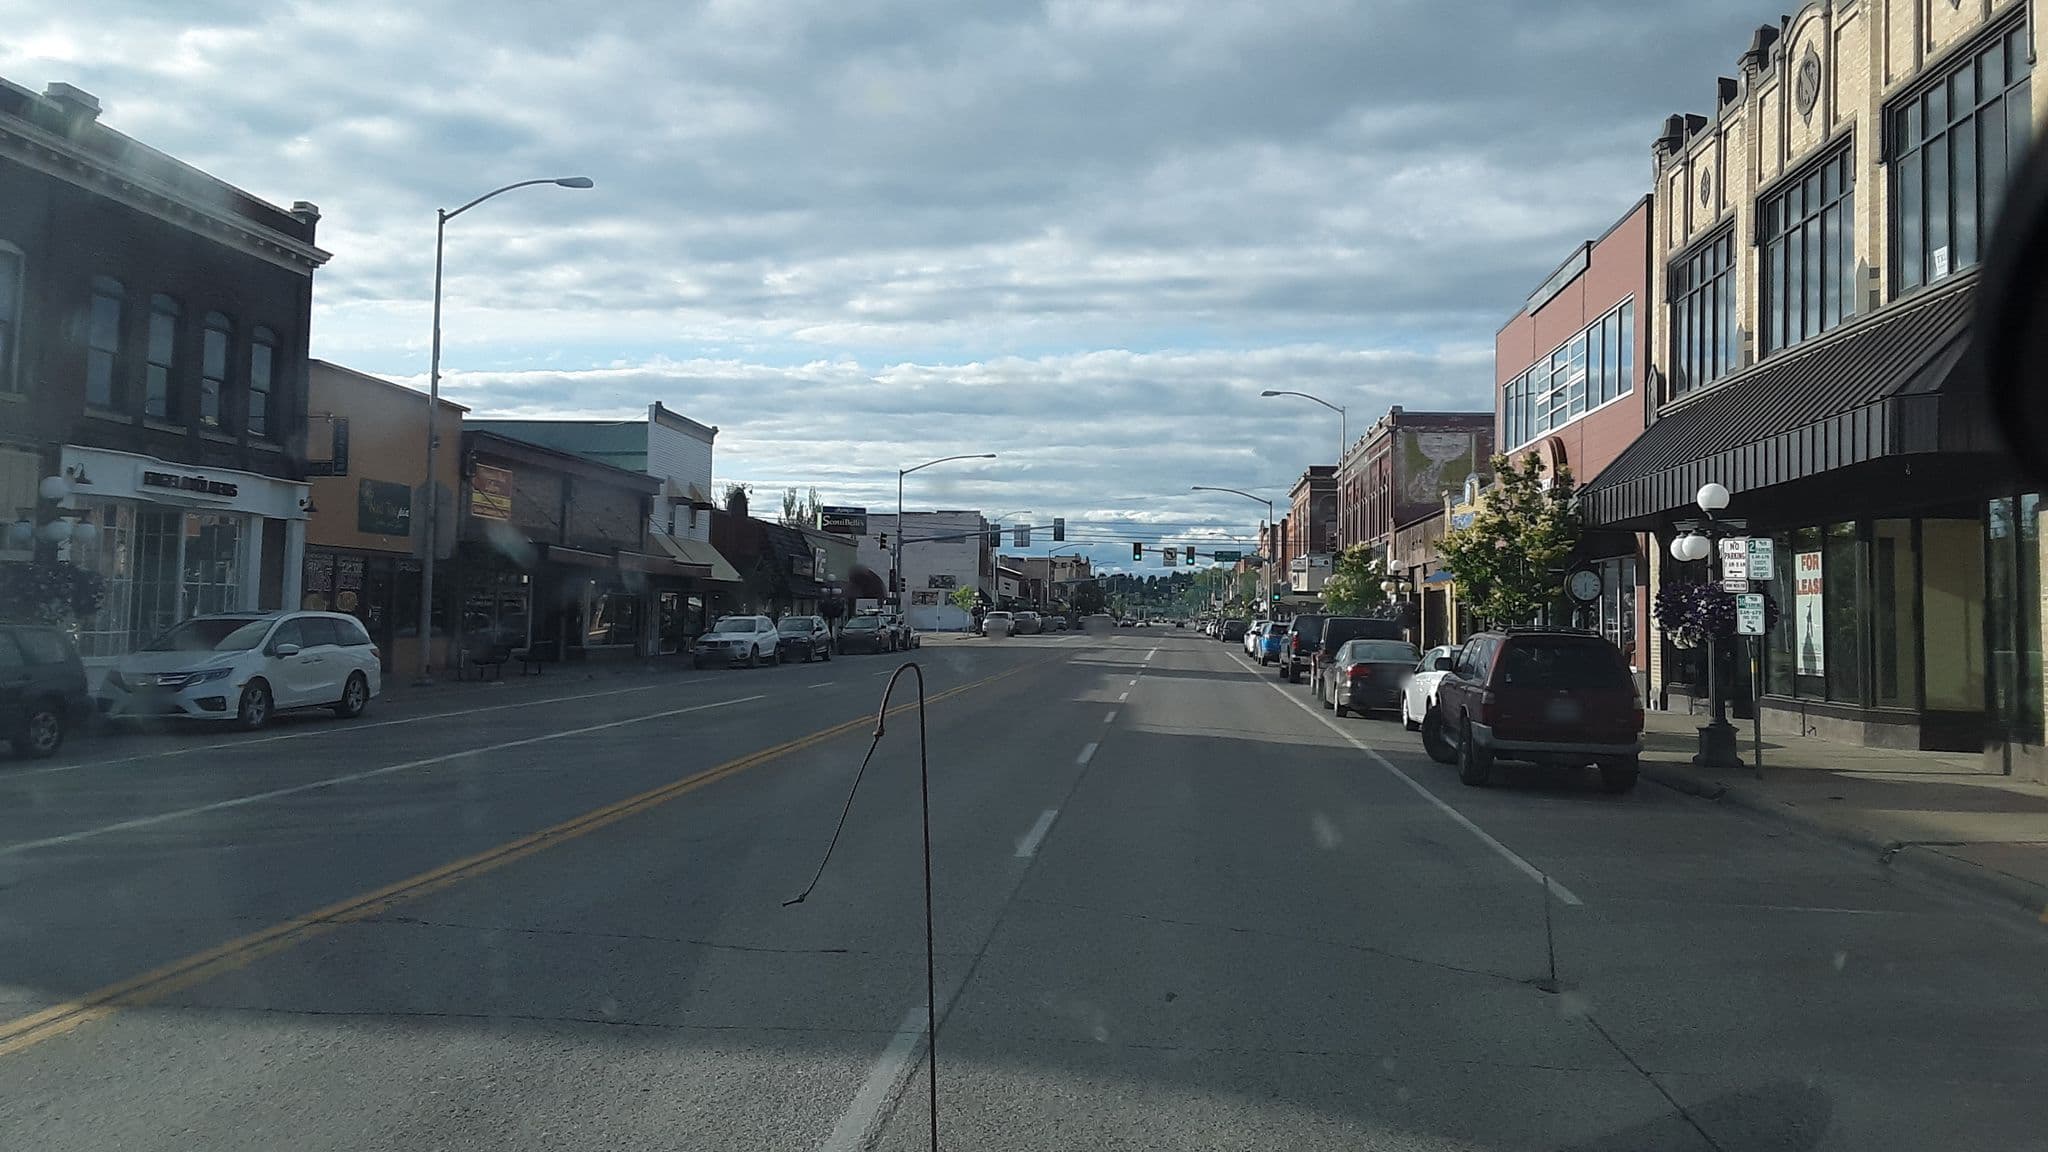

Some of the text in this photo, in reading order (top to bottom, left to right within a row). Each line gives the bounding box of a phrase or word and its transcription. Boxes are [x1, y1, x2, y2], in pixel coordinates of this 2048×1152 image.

[1730, 543, 1740, 551] NO
[1749, 541, 1755, 551] 2
[1724, 552, 1745, 560] PARKING
[1801, 554, 1819, 571] FOR
